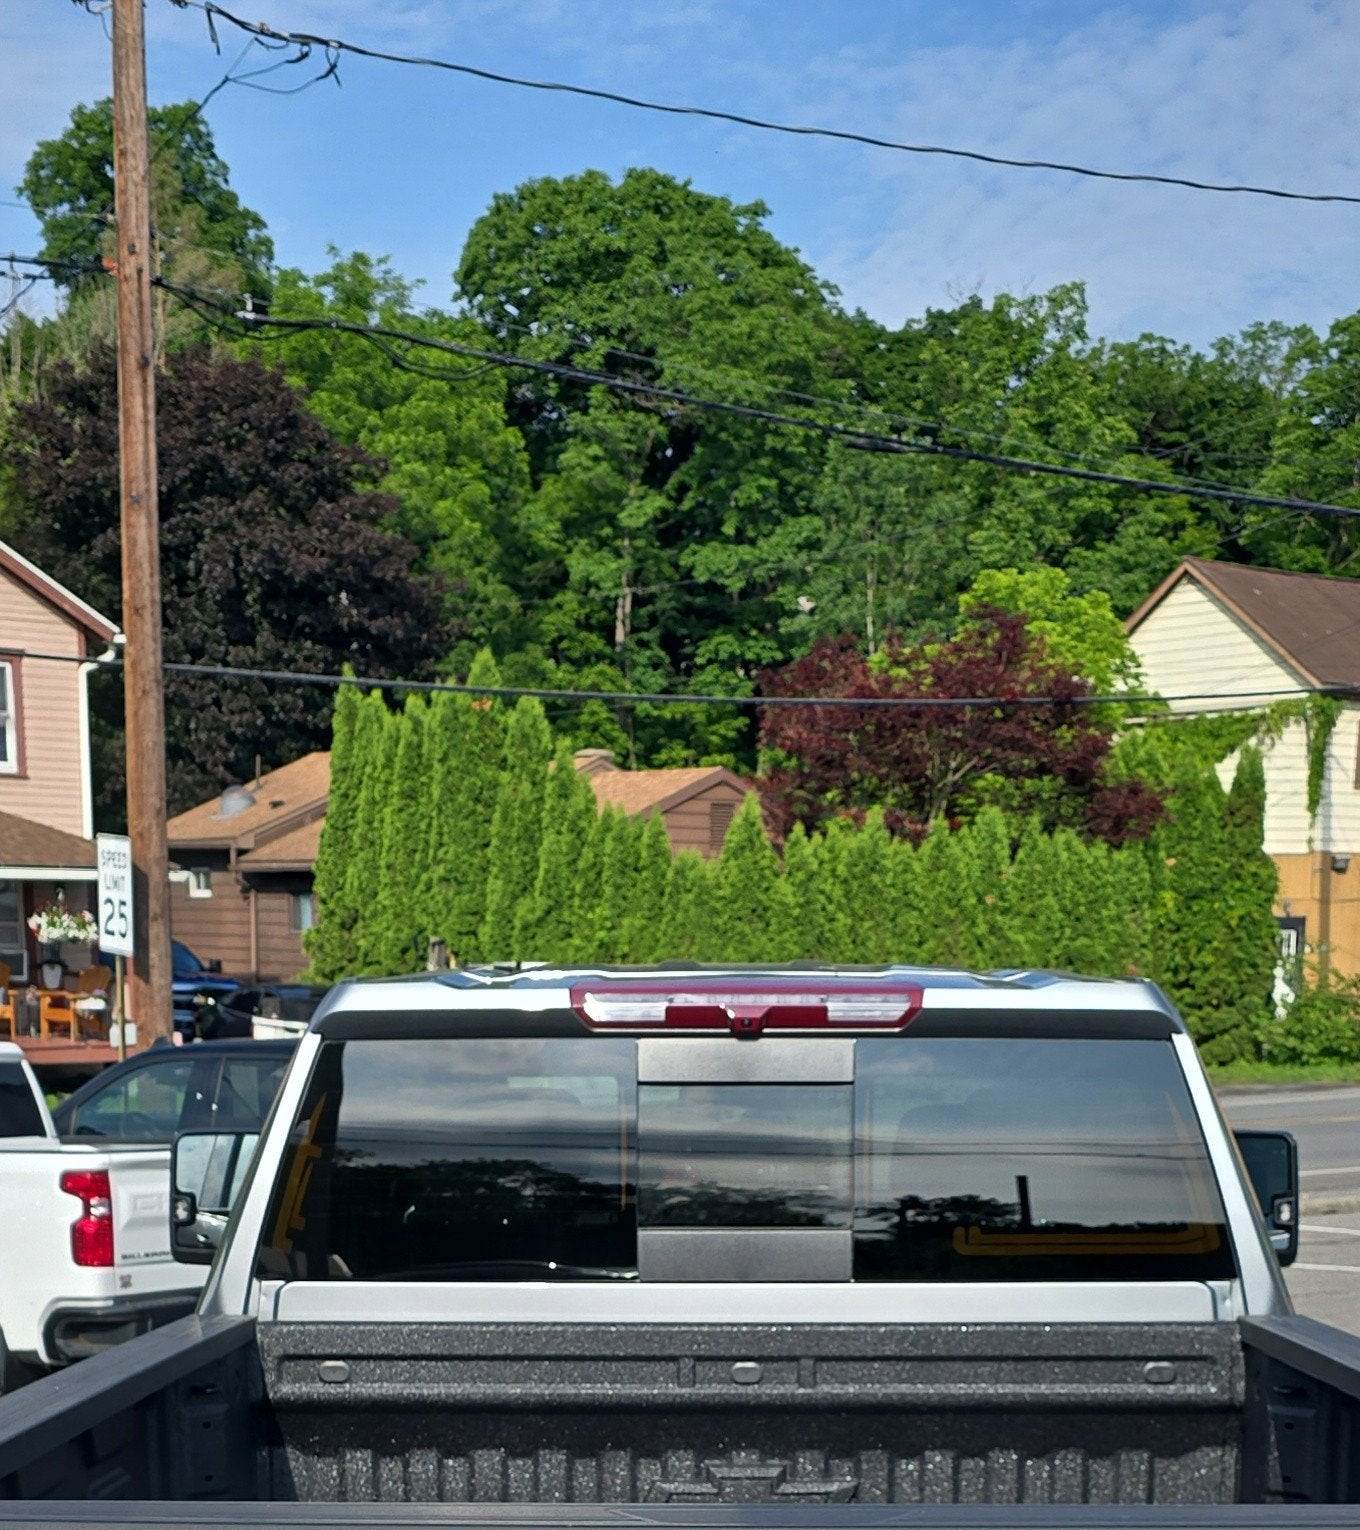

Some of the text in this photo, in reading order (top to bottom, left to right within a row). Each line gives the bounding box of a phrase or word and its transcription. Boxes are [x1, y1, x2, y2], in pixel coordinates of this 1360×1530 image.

[101, 849, 127, 869] SPEED
[104, 874, 126, 893] LIMIT
[104, 897, 128, 939] 25
